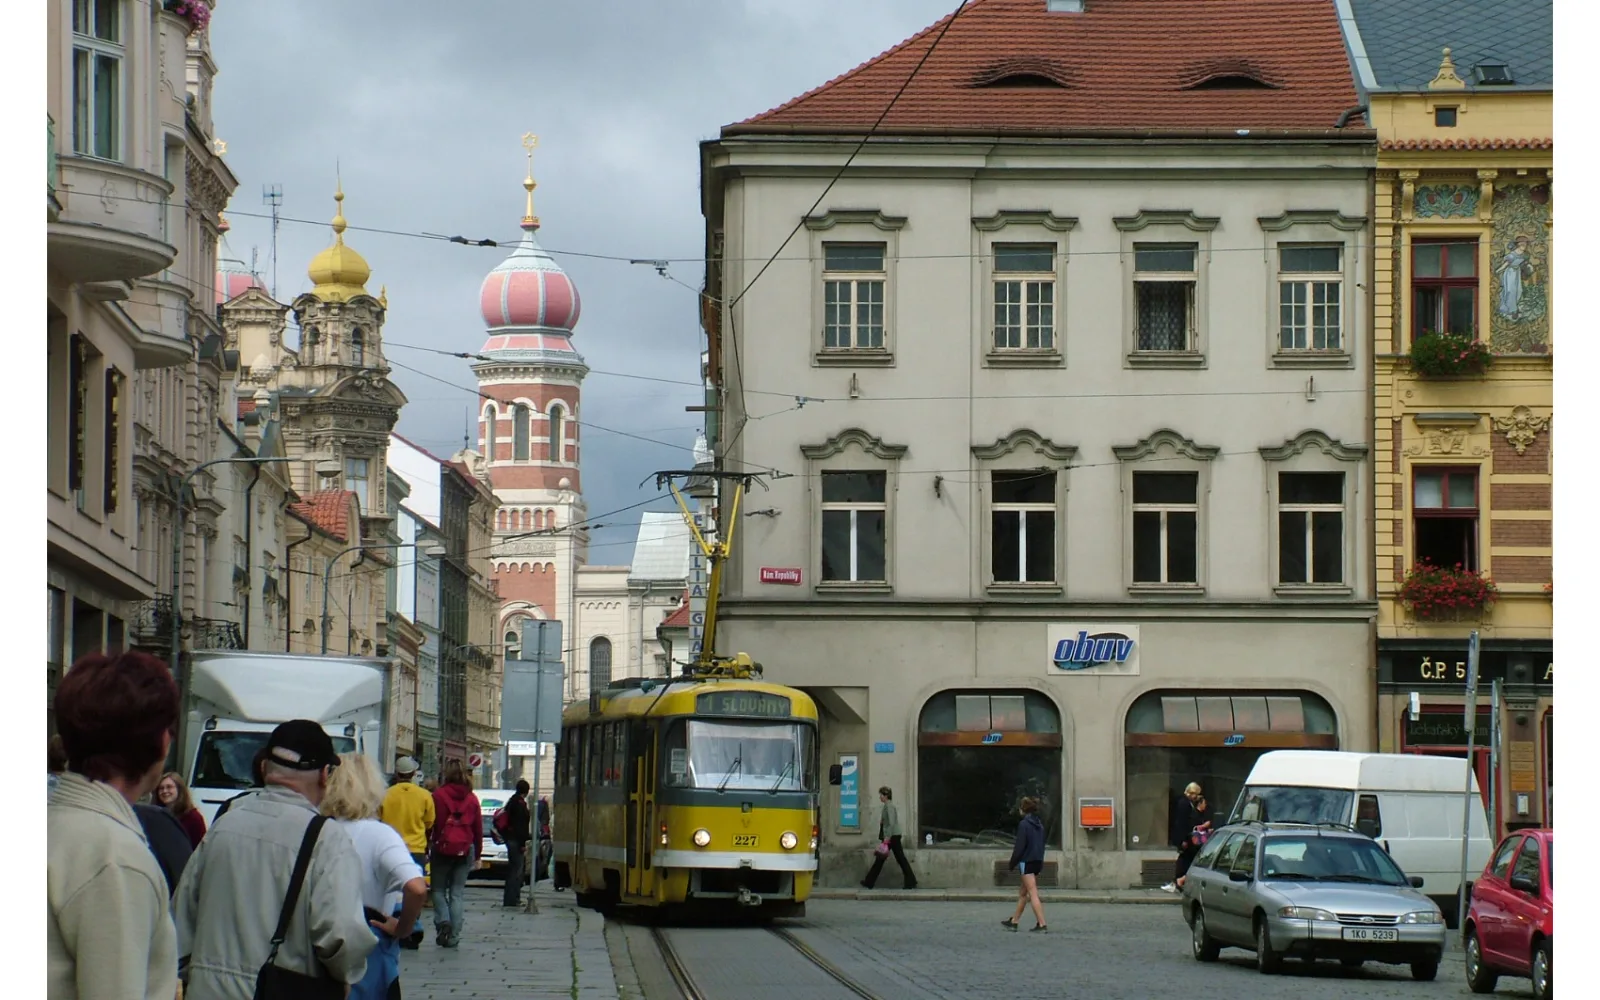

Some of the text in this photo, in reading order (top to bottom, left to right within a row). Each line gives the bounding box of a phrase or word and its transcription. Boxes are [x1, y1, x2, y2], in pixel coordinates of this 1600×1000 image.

[1053, 630, 1134, 662] obuv
[704, 695, 786, 714] 1 SLOVANY
[735, 835, 757, 846] 227
[1372, 930, 1394, 940] 5239
